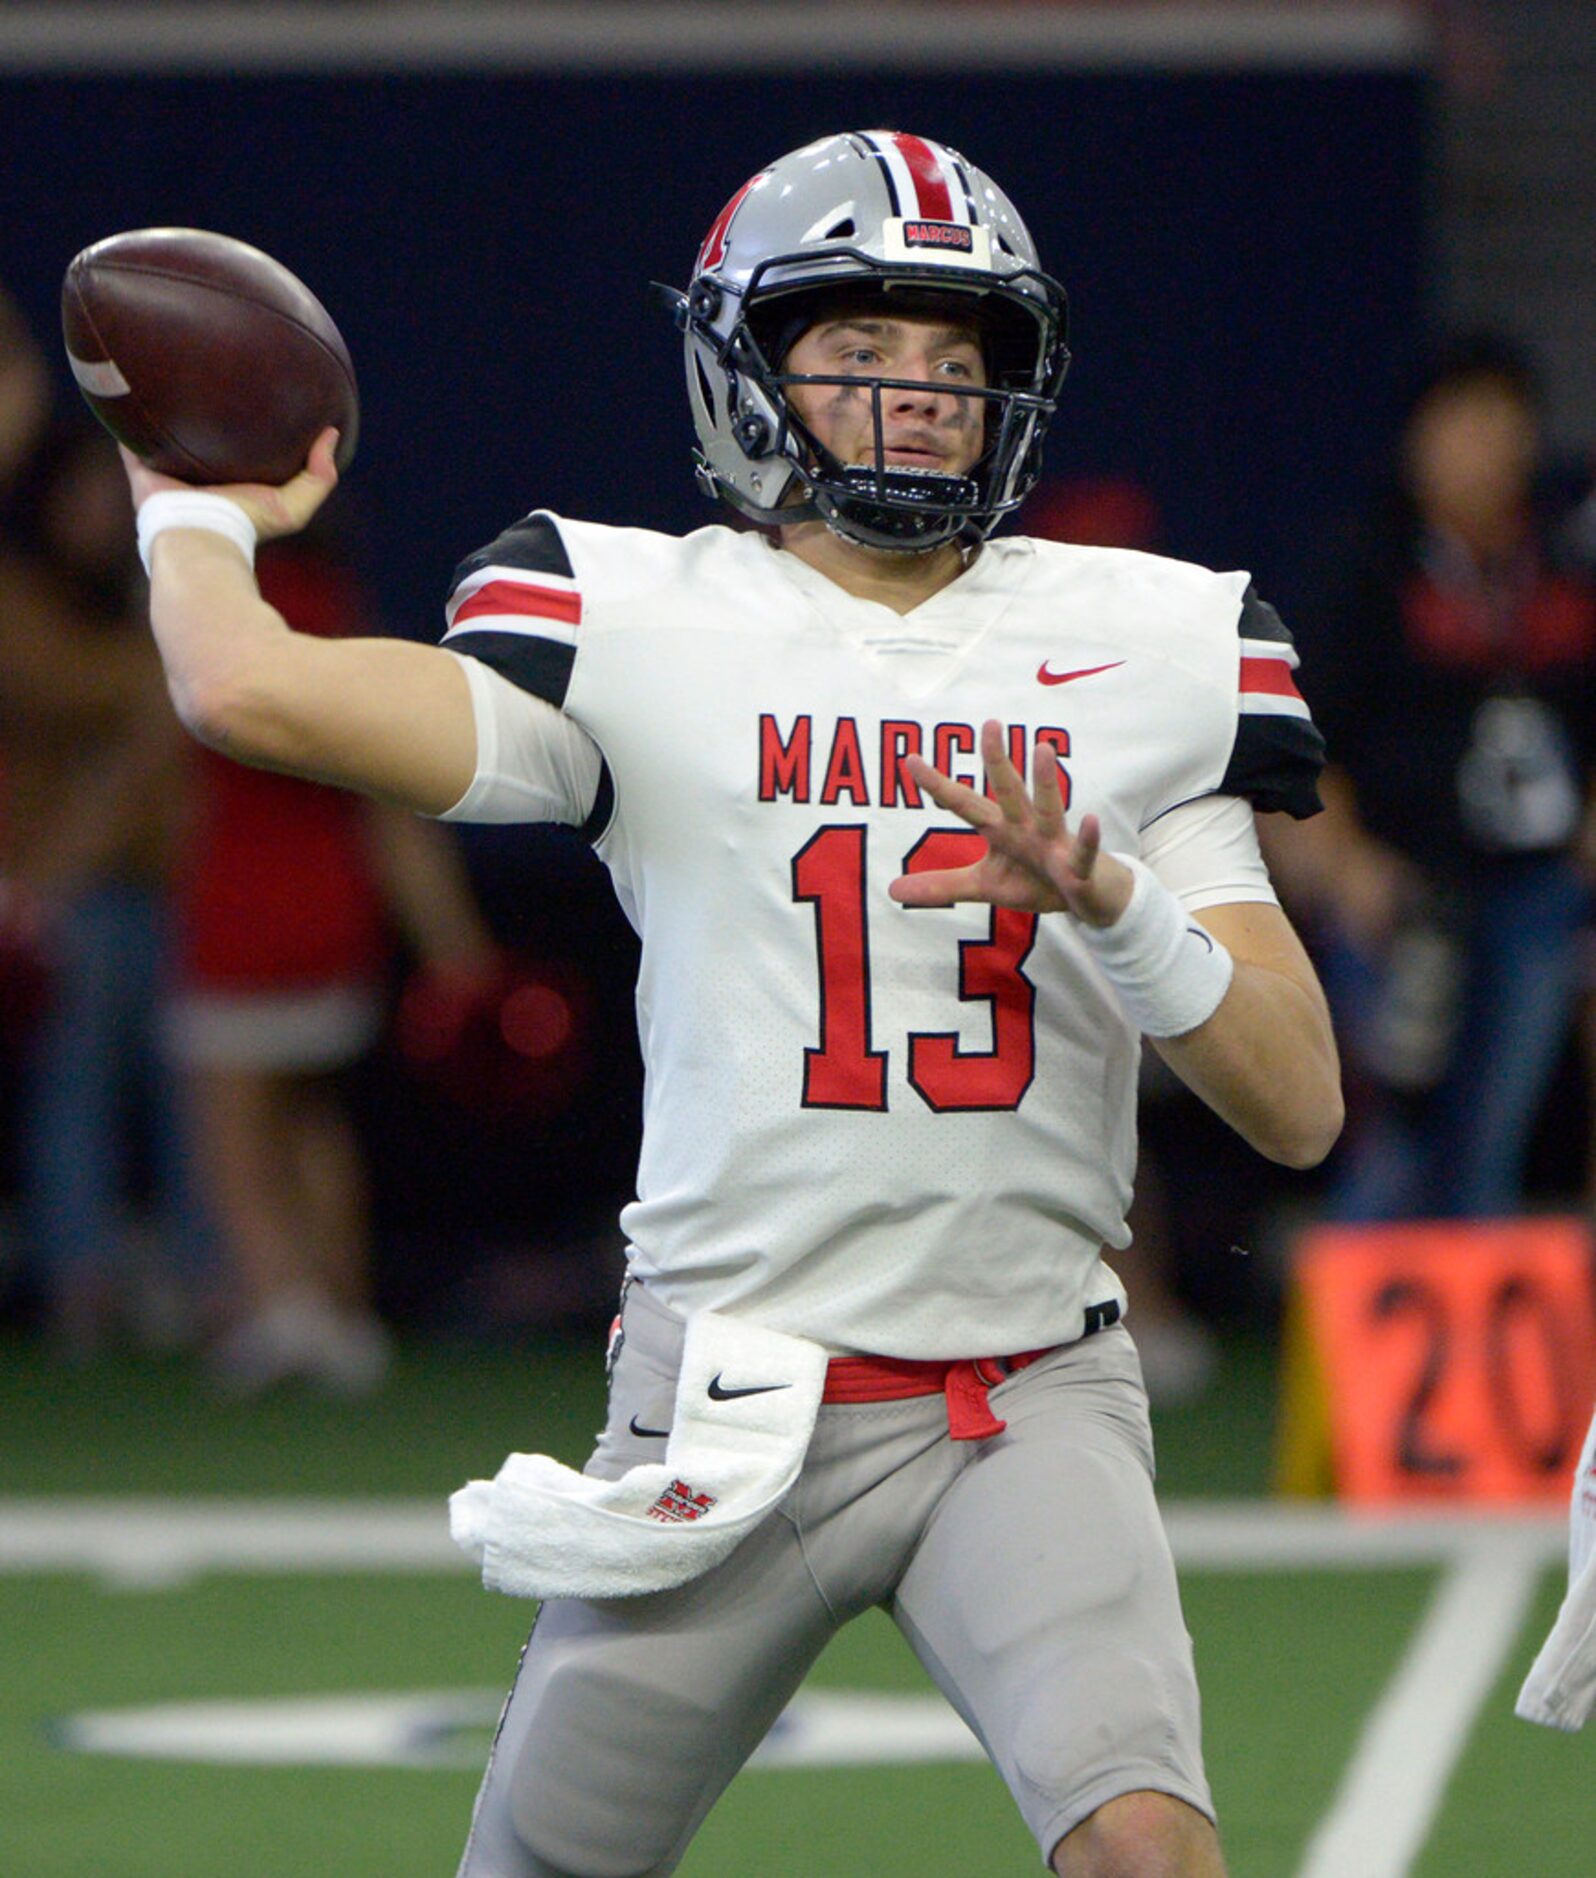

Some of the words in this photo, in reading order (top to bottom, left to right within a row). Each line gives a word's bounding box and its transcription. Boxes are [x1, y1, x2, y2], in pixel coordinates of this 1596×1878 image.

[906, 224, 970, 247] MARCUS
[791, 823, 1039, 1113] 13
[1367, 1276, 1574, 1480] 20
